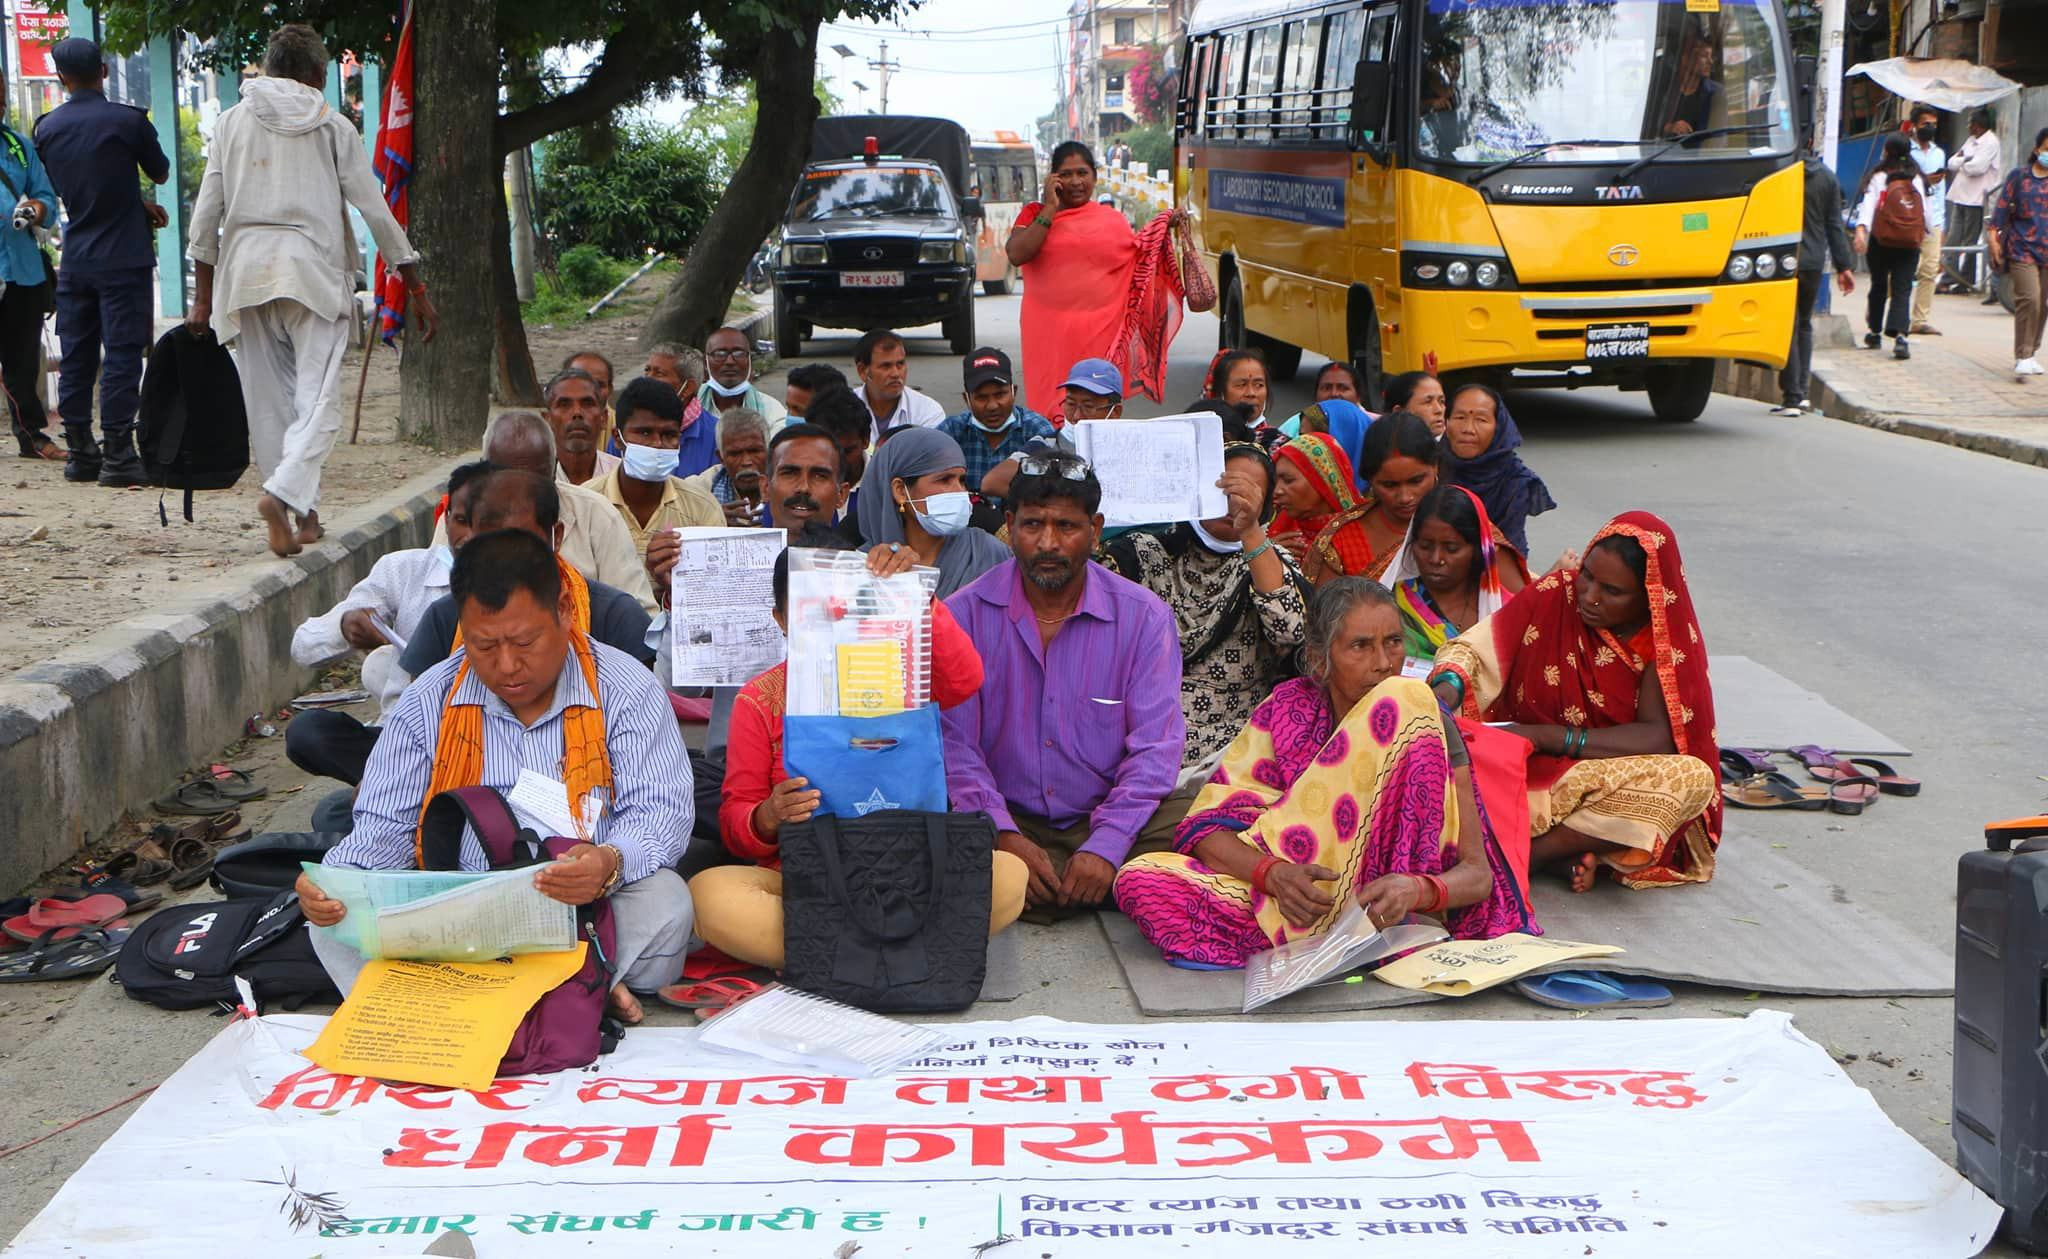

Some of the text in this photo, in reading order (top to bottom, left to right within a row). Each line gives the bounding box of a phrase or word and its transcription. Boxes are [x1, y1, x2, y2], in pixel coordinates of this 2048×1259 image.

[1223, 175, 1337, 210] LABORATORY SECONDARY SCHOOL
[1595, 185, 1644, 199] TATA
[173, 912, 218, 955] FILA
[896, 1076, 1108, 1104] तथा
[1150, 1066, 1366, 1102] ठगी
[384, 1111, 1541, 1169] धर्ना कार्यक्रम
[1020, 1194, 1134, 1213] मिटर
[1276, 1197, 1363, 1211] तथा
[1379, 1193, 1467, 1209] ठगी
[508, 1209, 659, 1234] संघर्ष
[679, 1207, 820, 1231] जारी
[1357, 1217, 1468, 1236] संघर्ष
[1484, 1215, 1629, 1235] समिति
